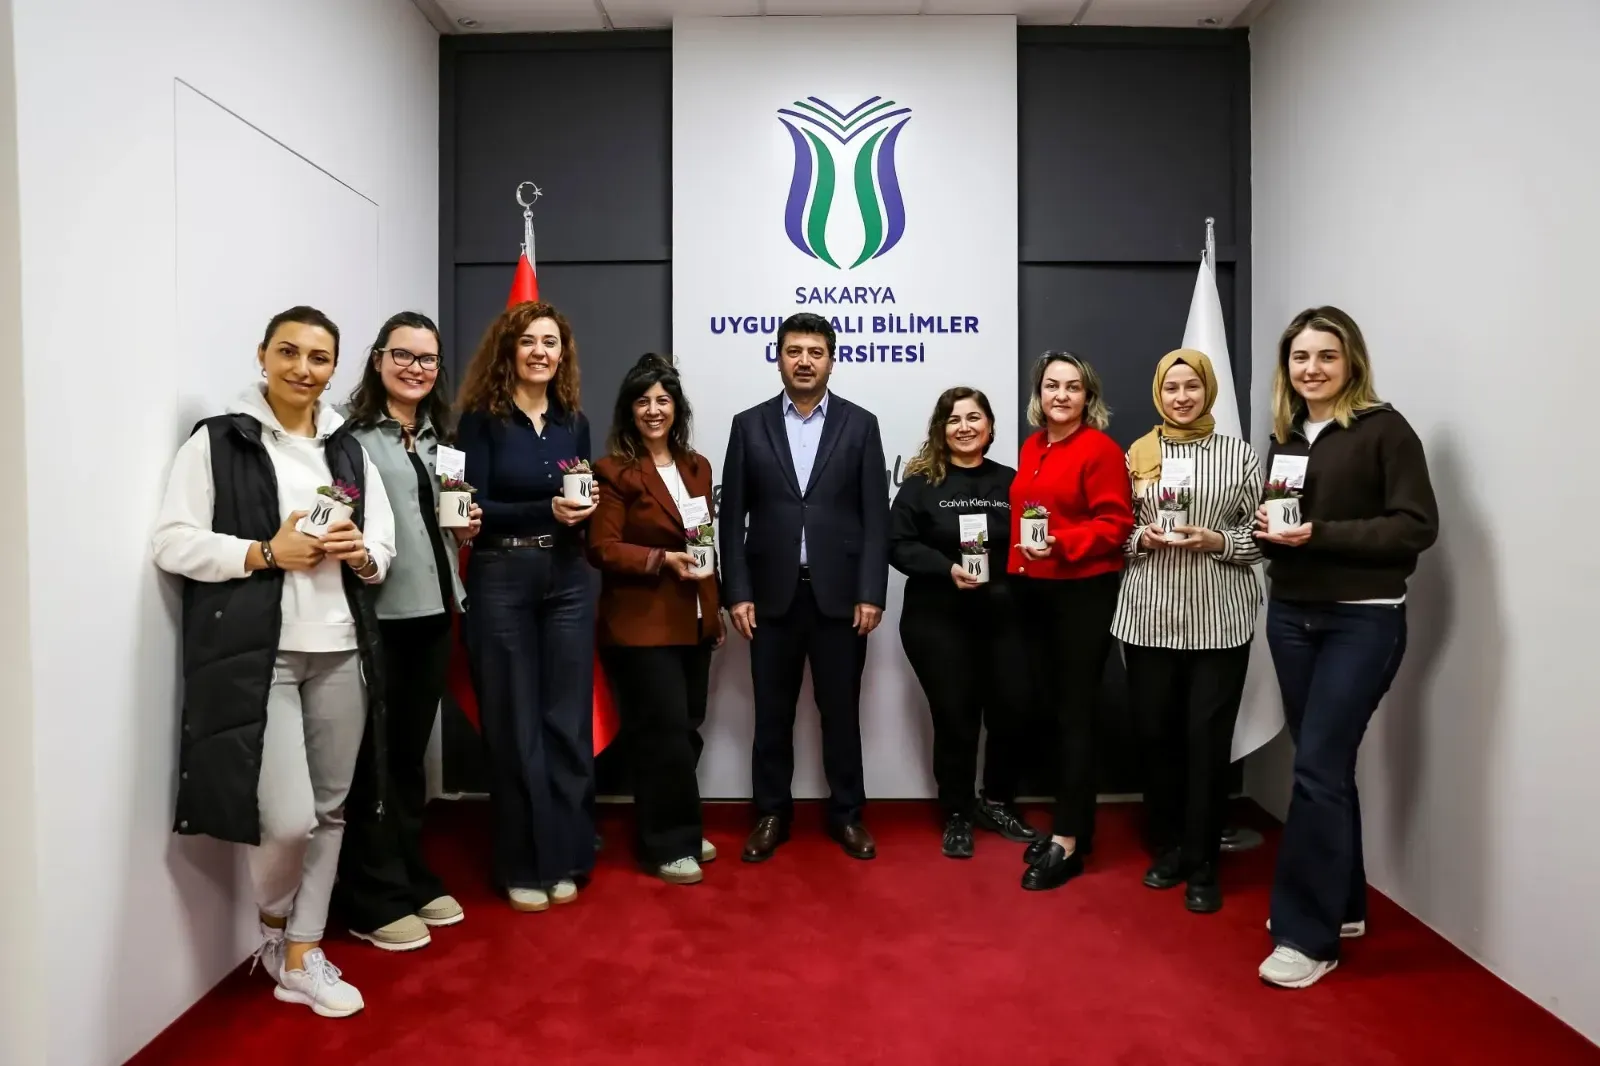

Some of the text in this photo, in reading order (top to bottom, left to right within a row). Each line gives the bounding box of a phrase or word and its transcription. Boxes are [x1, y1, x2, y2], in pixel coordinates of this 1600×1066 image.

[795, 286, 896, 304] SAKARYA
[710, 313, 980, 334] UYGUALI BİLİMLER
[765, 341, 925, 363] ÜRSİTESİ
[939, 498, 969, 508] Calvin
[969, 497, 991, 507] Klein
